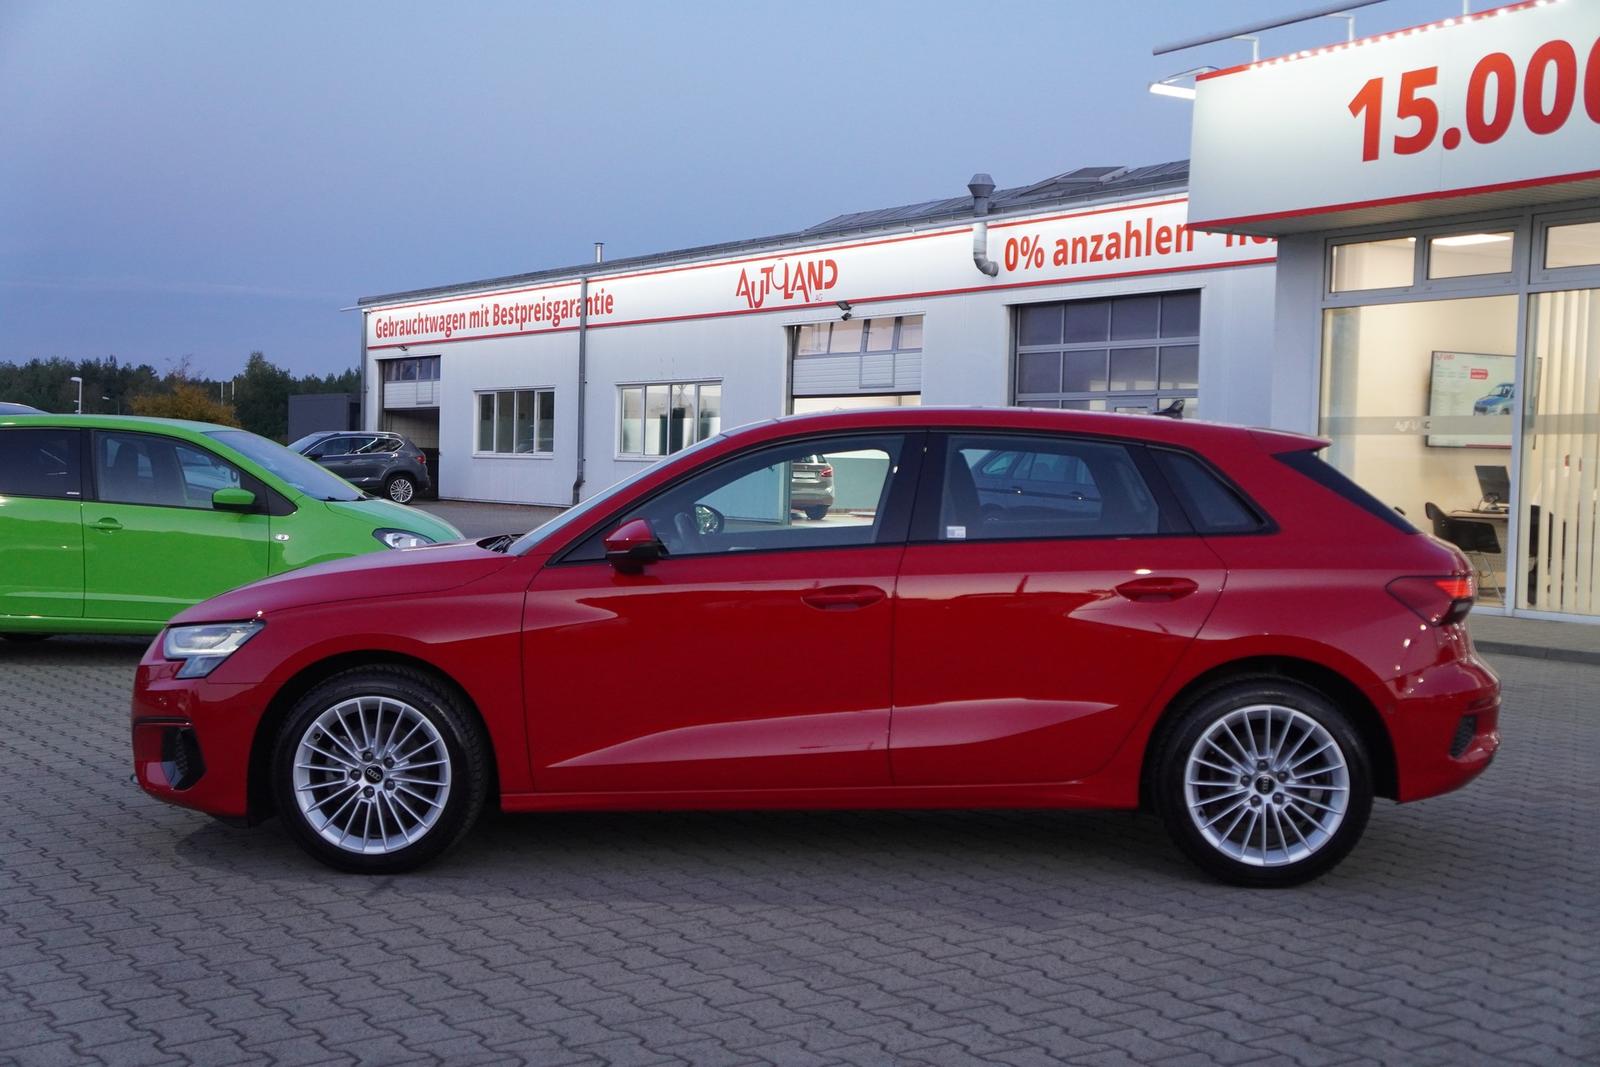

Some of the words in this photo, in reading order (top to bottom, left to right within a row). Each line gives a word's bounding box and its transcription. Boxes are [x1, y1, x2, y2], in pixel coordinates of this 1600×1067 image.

[1004, 234, 1045, 272] 0%
[1053, 218, 1194, 267] anzahlen
[375, 312, 466, 339] Gebrauchtwagen
[469, 304, 490, 329] mit
[493, 288, 614, 331] Bestpreisgarantie
